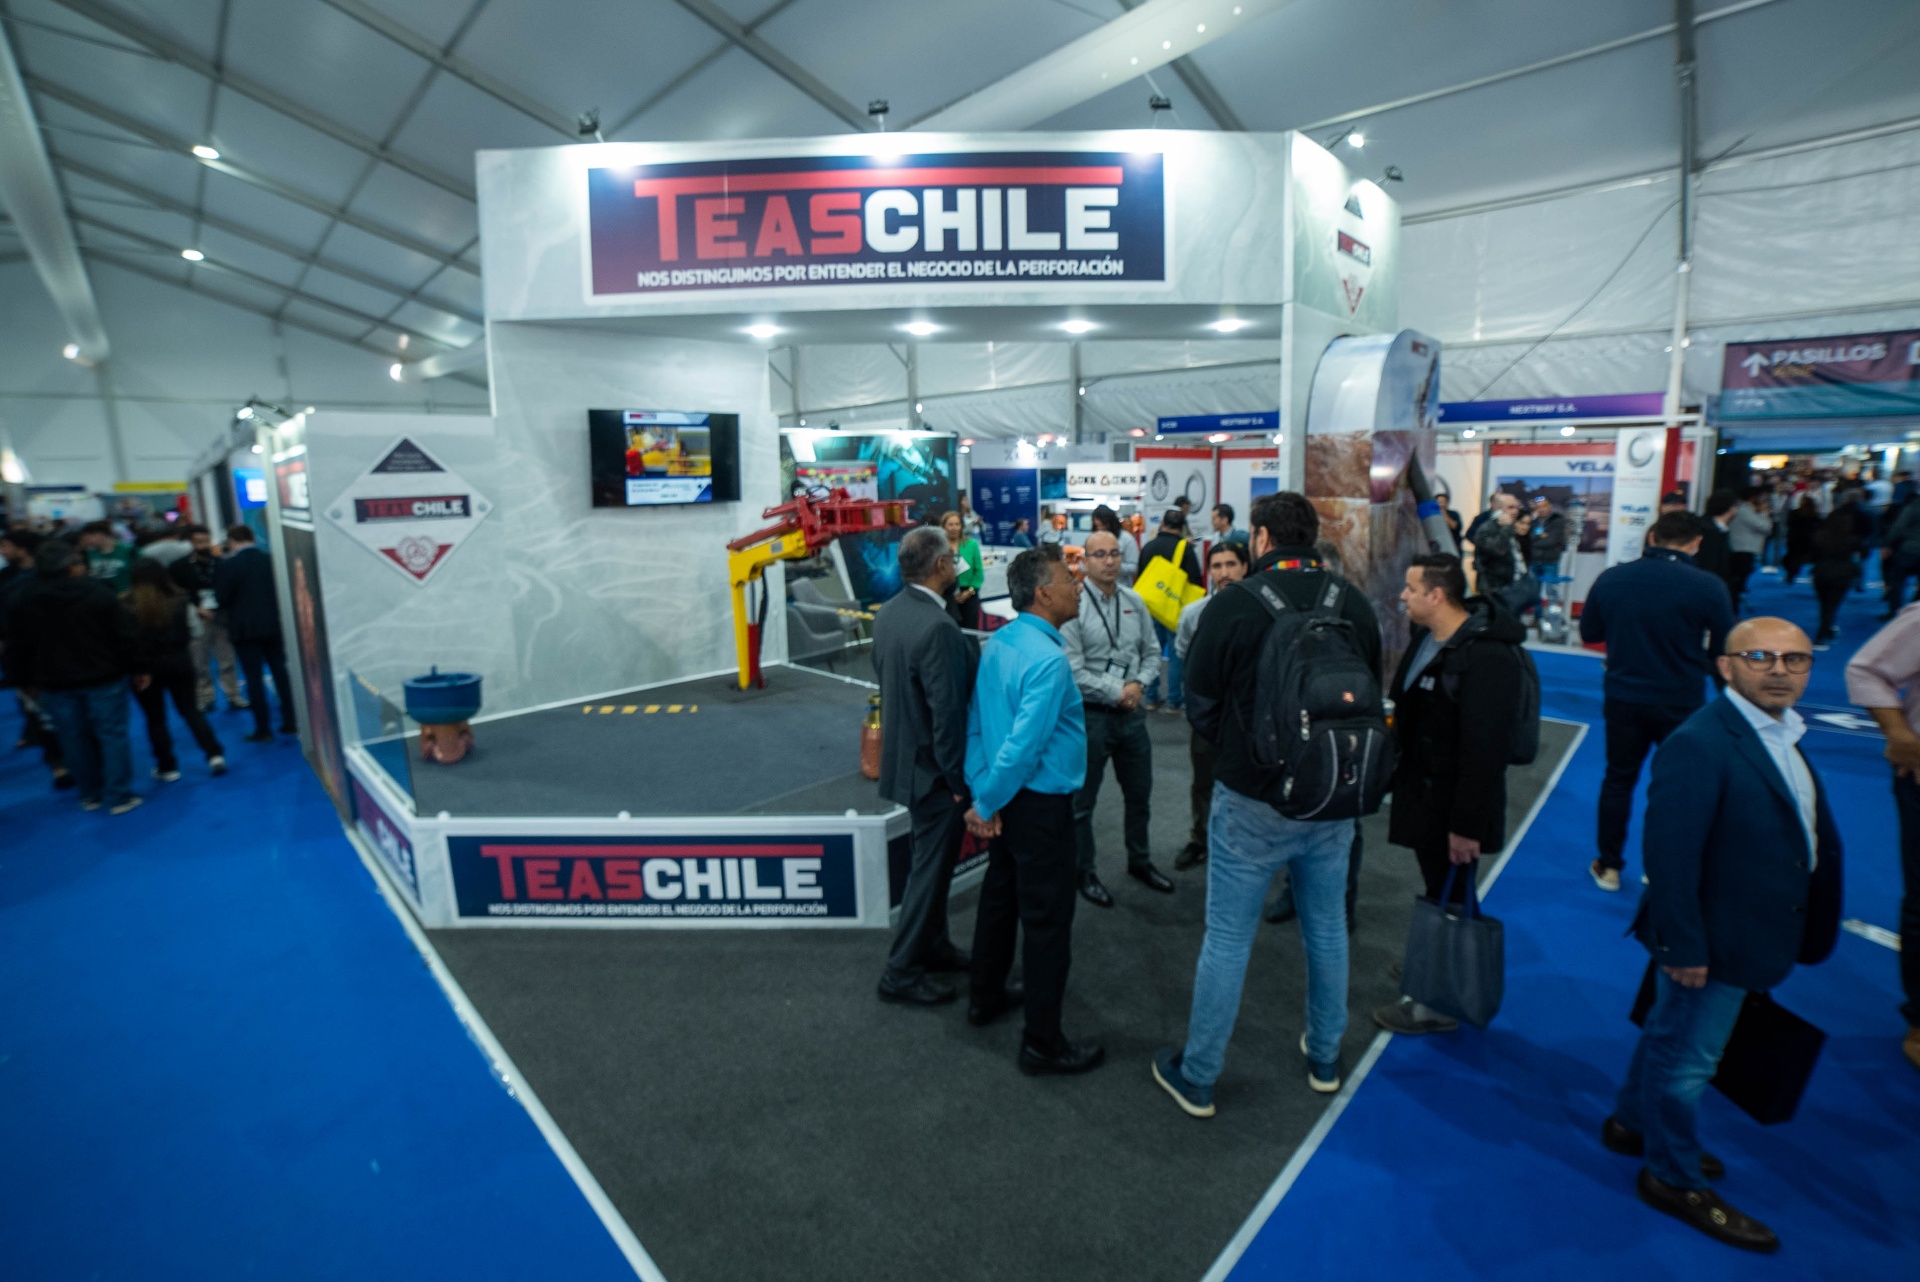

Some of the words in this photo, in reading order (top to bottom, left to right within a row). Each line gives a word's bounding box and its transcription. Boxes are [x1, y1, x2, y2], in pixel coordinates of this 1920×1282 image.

[635, 165, 1123, 262] TEASCHILE
[637, 270, 670, 288] NOS
[671, 266, 773, 286] DISTINGUIMOS
[774, 264, 808, 282] POR
[809, 261, 885, 281] ENTENDER
[887, 260, 906, 278] EL
[907, 260, 972, 278] NEGOCIO
[974, 260, 994, 276] DE
[995, 259, 1018, 276] LA
[1018, 254, 1124, 276] PERFORACIÓN
[1770, 342, 1888, 366] PASILLOS
[1508, 403, 1555, 415] NEXTWAY
[1557, 402, 1577, 413] S.A.
[480, 844, 824, 900] TEASCHILE
[662, 903, 674, 916] EL
[722, 903, 736, 916] DE
[737, 903, 754, 916] LA
